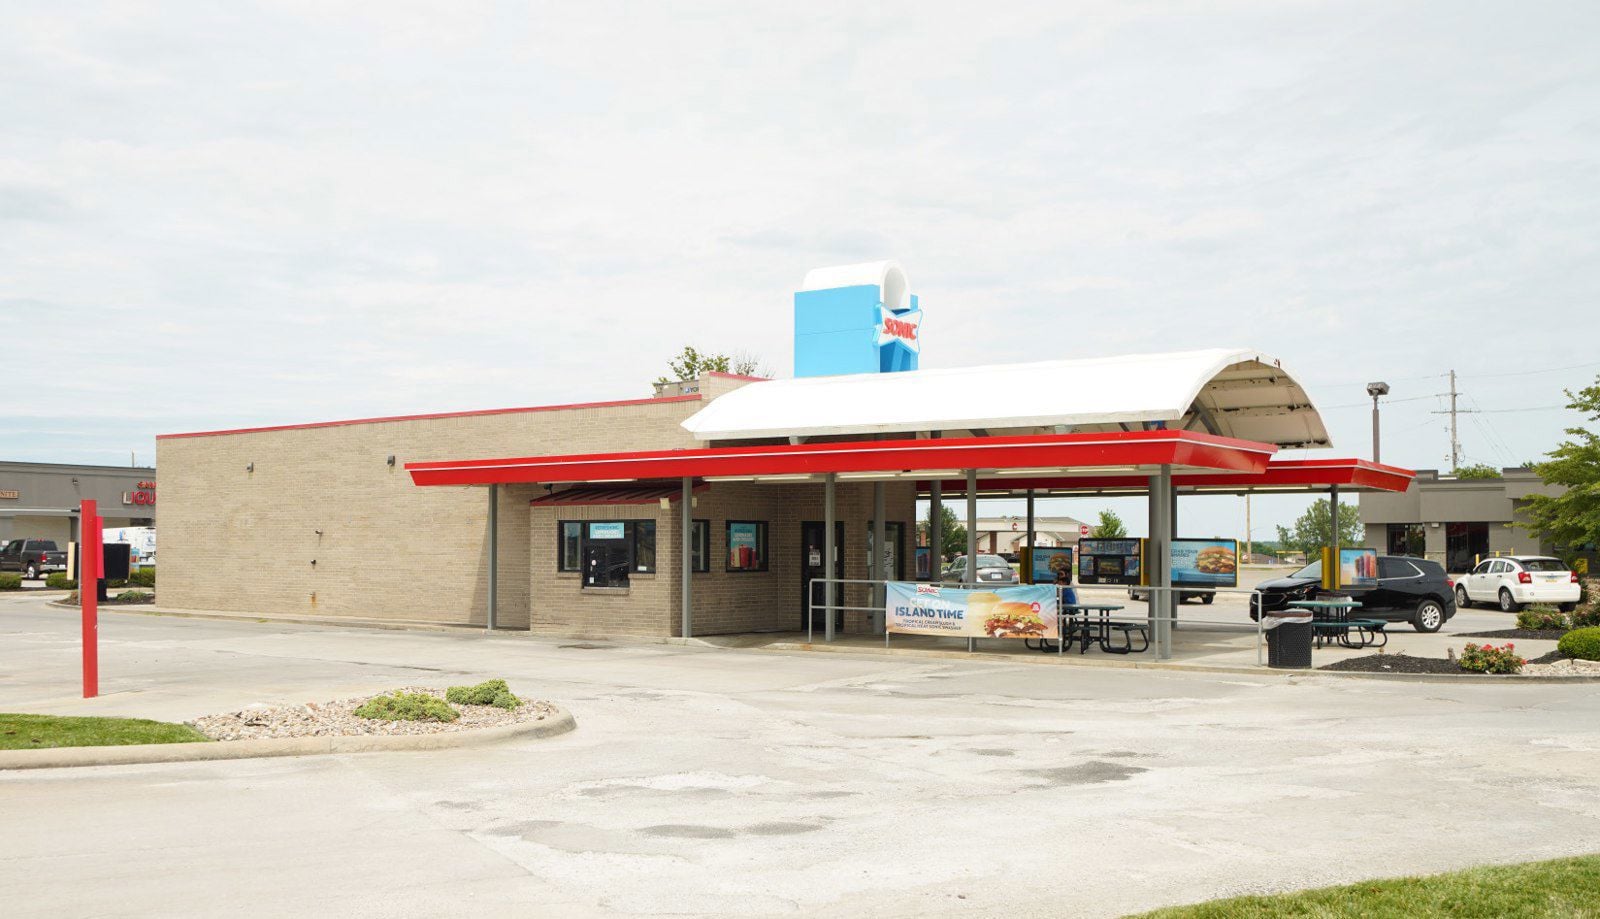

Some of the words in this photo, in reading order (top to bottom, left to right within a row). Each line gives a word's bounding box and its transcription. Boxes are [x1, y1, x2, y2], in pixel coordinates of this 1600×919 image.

[883, 316, 917, 340] SONIC
[895, 607, 936, 618] ISLAND
[936, 609, 964, 619] TIME
